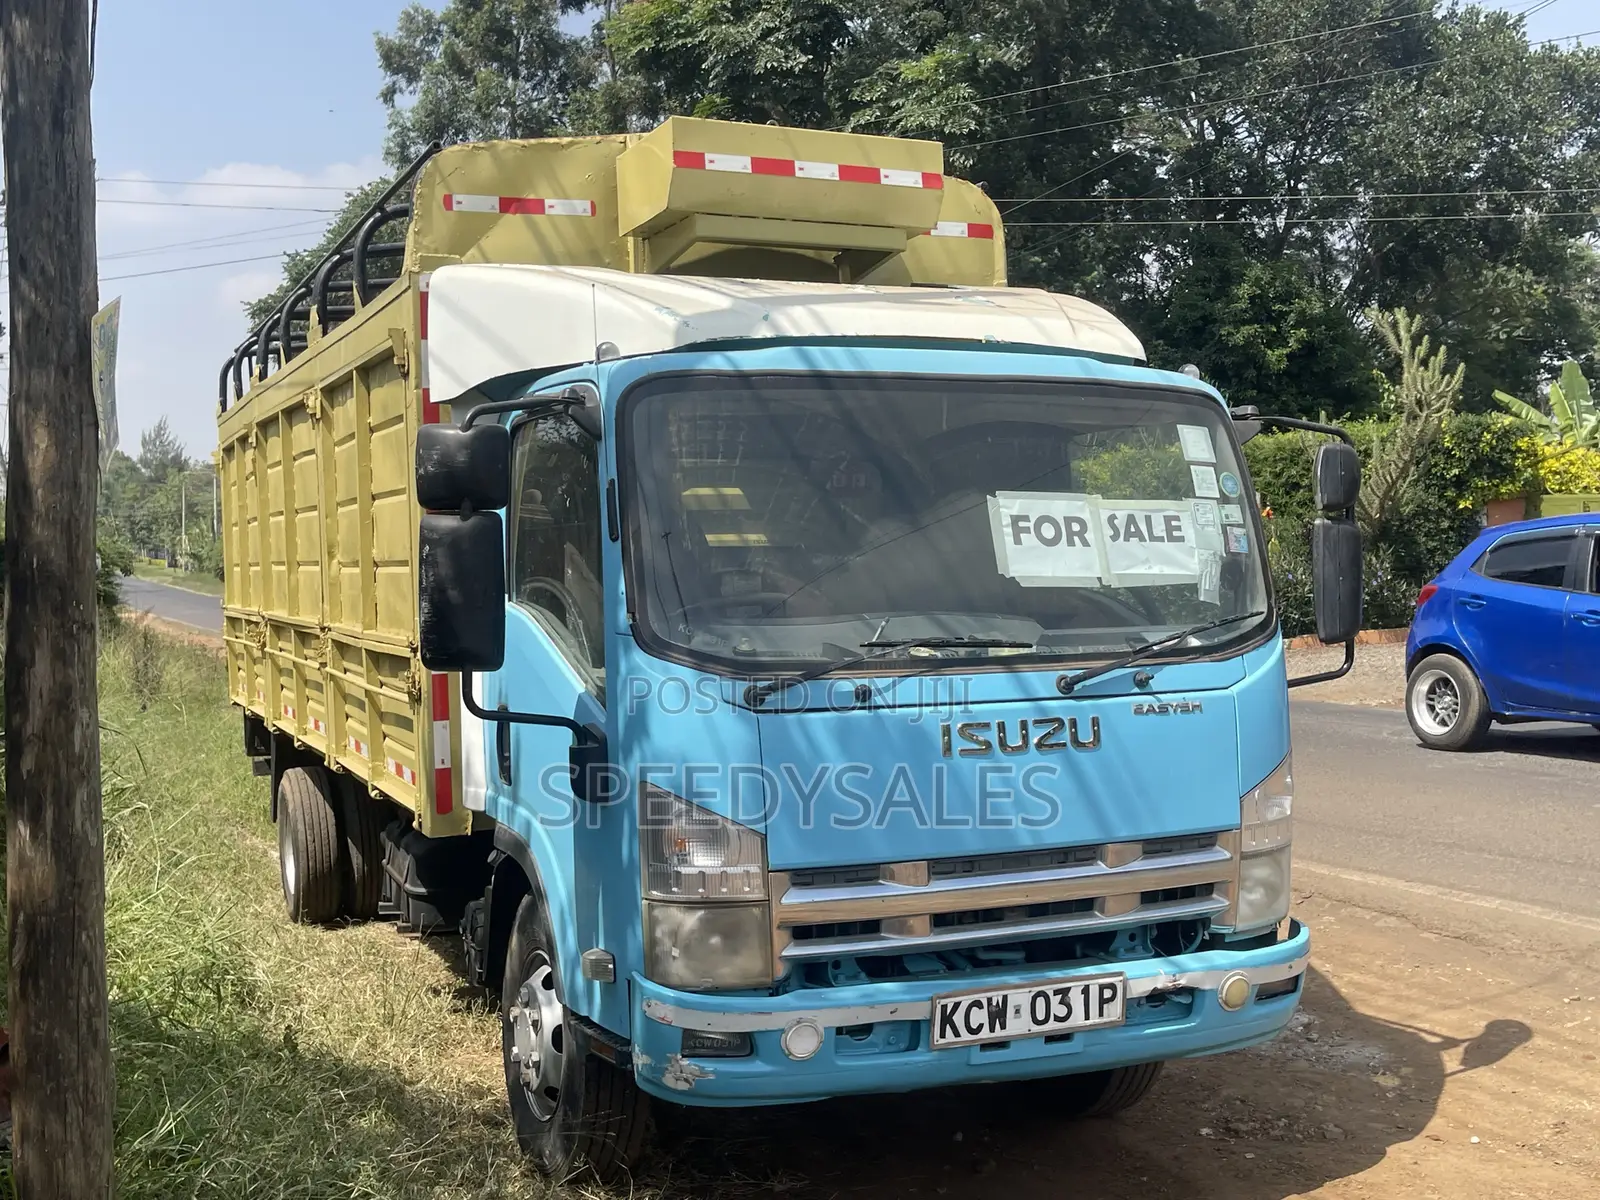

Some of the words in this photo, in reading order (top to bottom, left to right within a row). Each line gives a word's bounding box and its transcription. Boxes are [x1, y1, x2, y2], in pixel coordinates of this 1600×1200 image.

[1009, 514, 1091, 547] FOR
[1107, 513, 1185, 543] SALE
[940, 715, 1101, 758] ISUZU
[939, 994, 1009, 1039] KCW
[1029, 982, 1118, 1027] 031P
